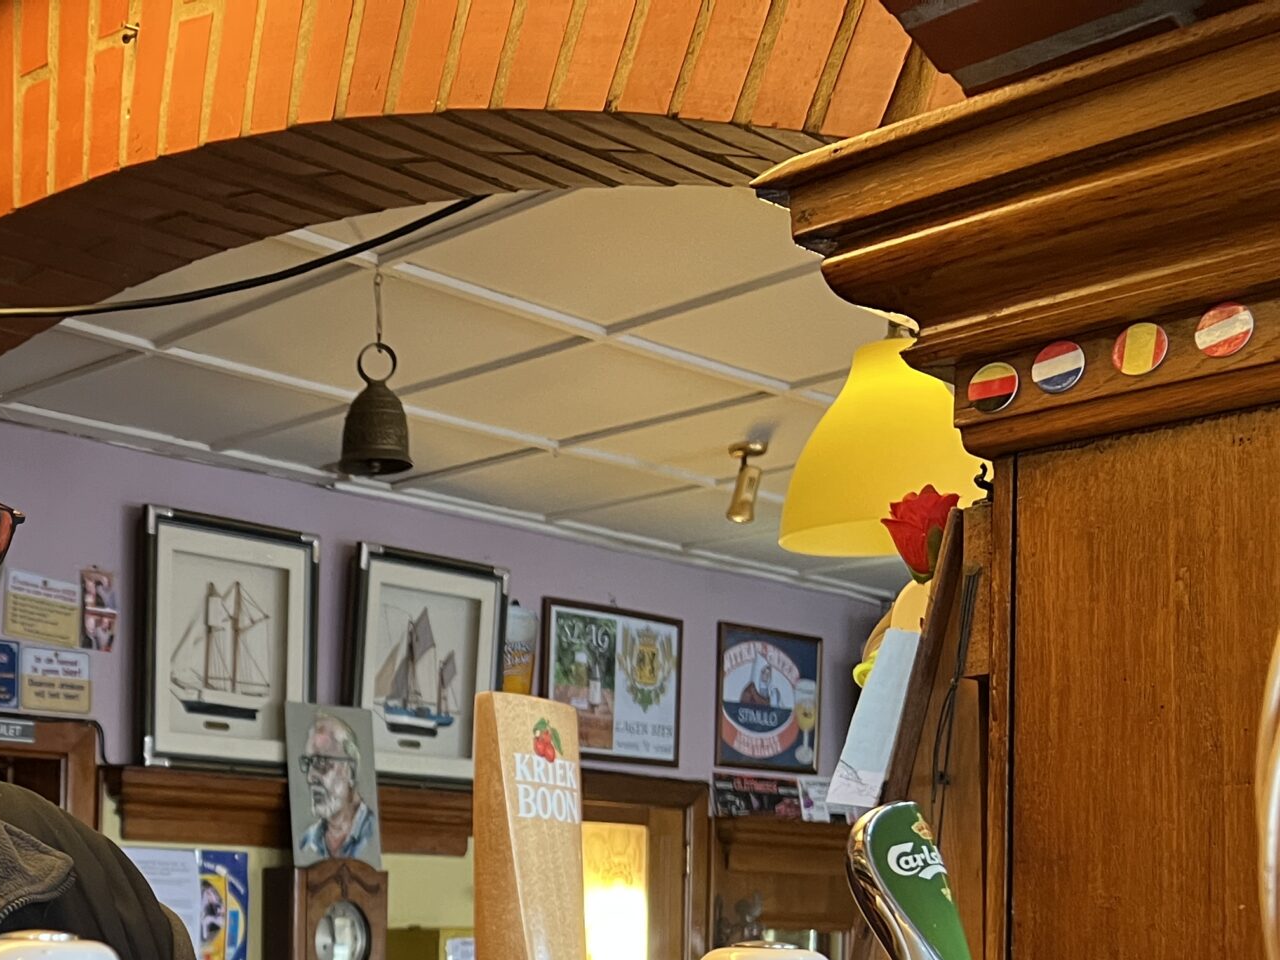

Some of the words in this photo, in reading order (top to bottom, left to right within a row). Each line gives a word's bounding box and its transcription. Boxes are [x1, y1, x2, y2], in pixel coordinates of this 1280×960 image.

[738, 707, 778, 726] STIMULO
[514, 752, 577, 789] KRIEK
[517, 784, 580, 825] BOON
